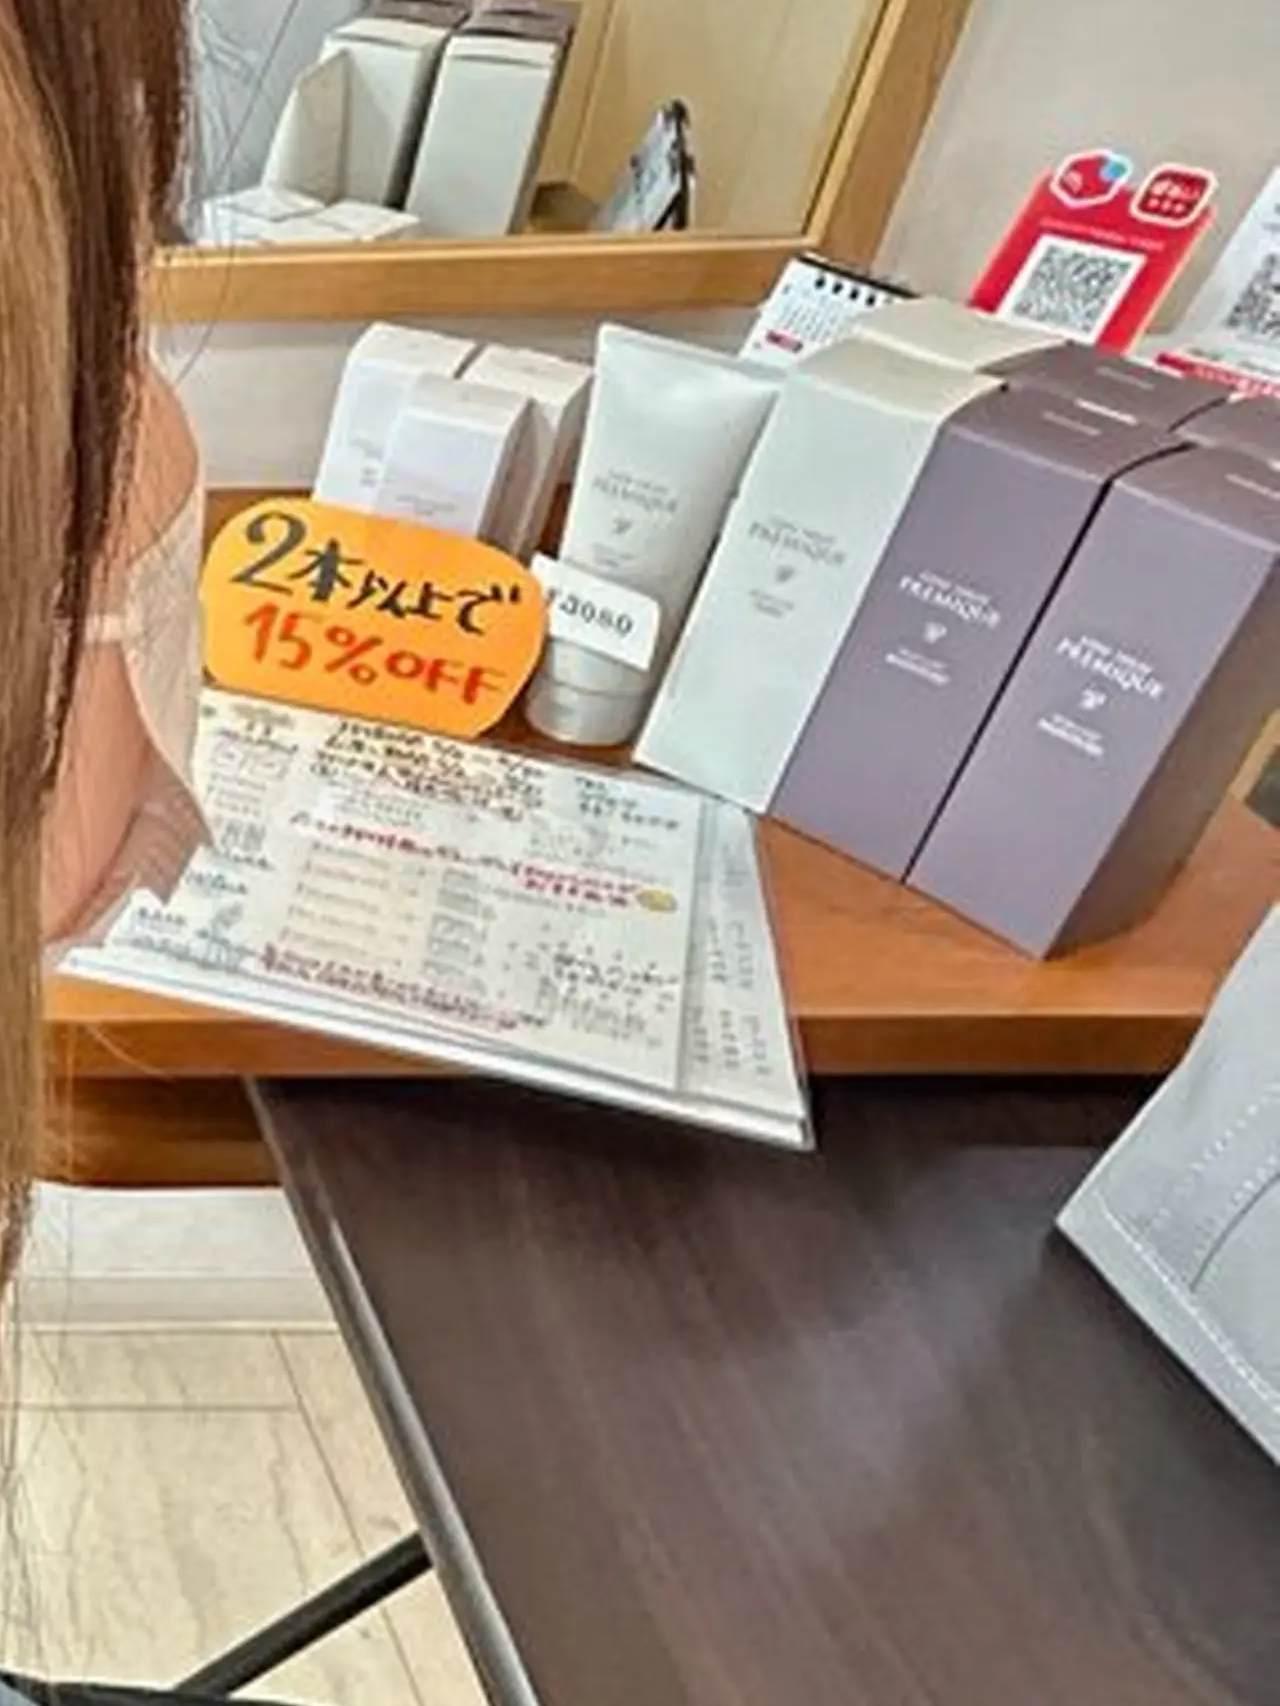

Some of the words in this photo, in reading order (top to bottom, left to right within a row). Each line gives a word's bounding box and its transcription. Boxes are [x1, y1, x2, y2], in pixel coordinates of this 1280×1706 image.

[229, 510, 522, 637] 2本以上で
[244, 601, 508, 706] 15%OFF
